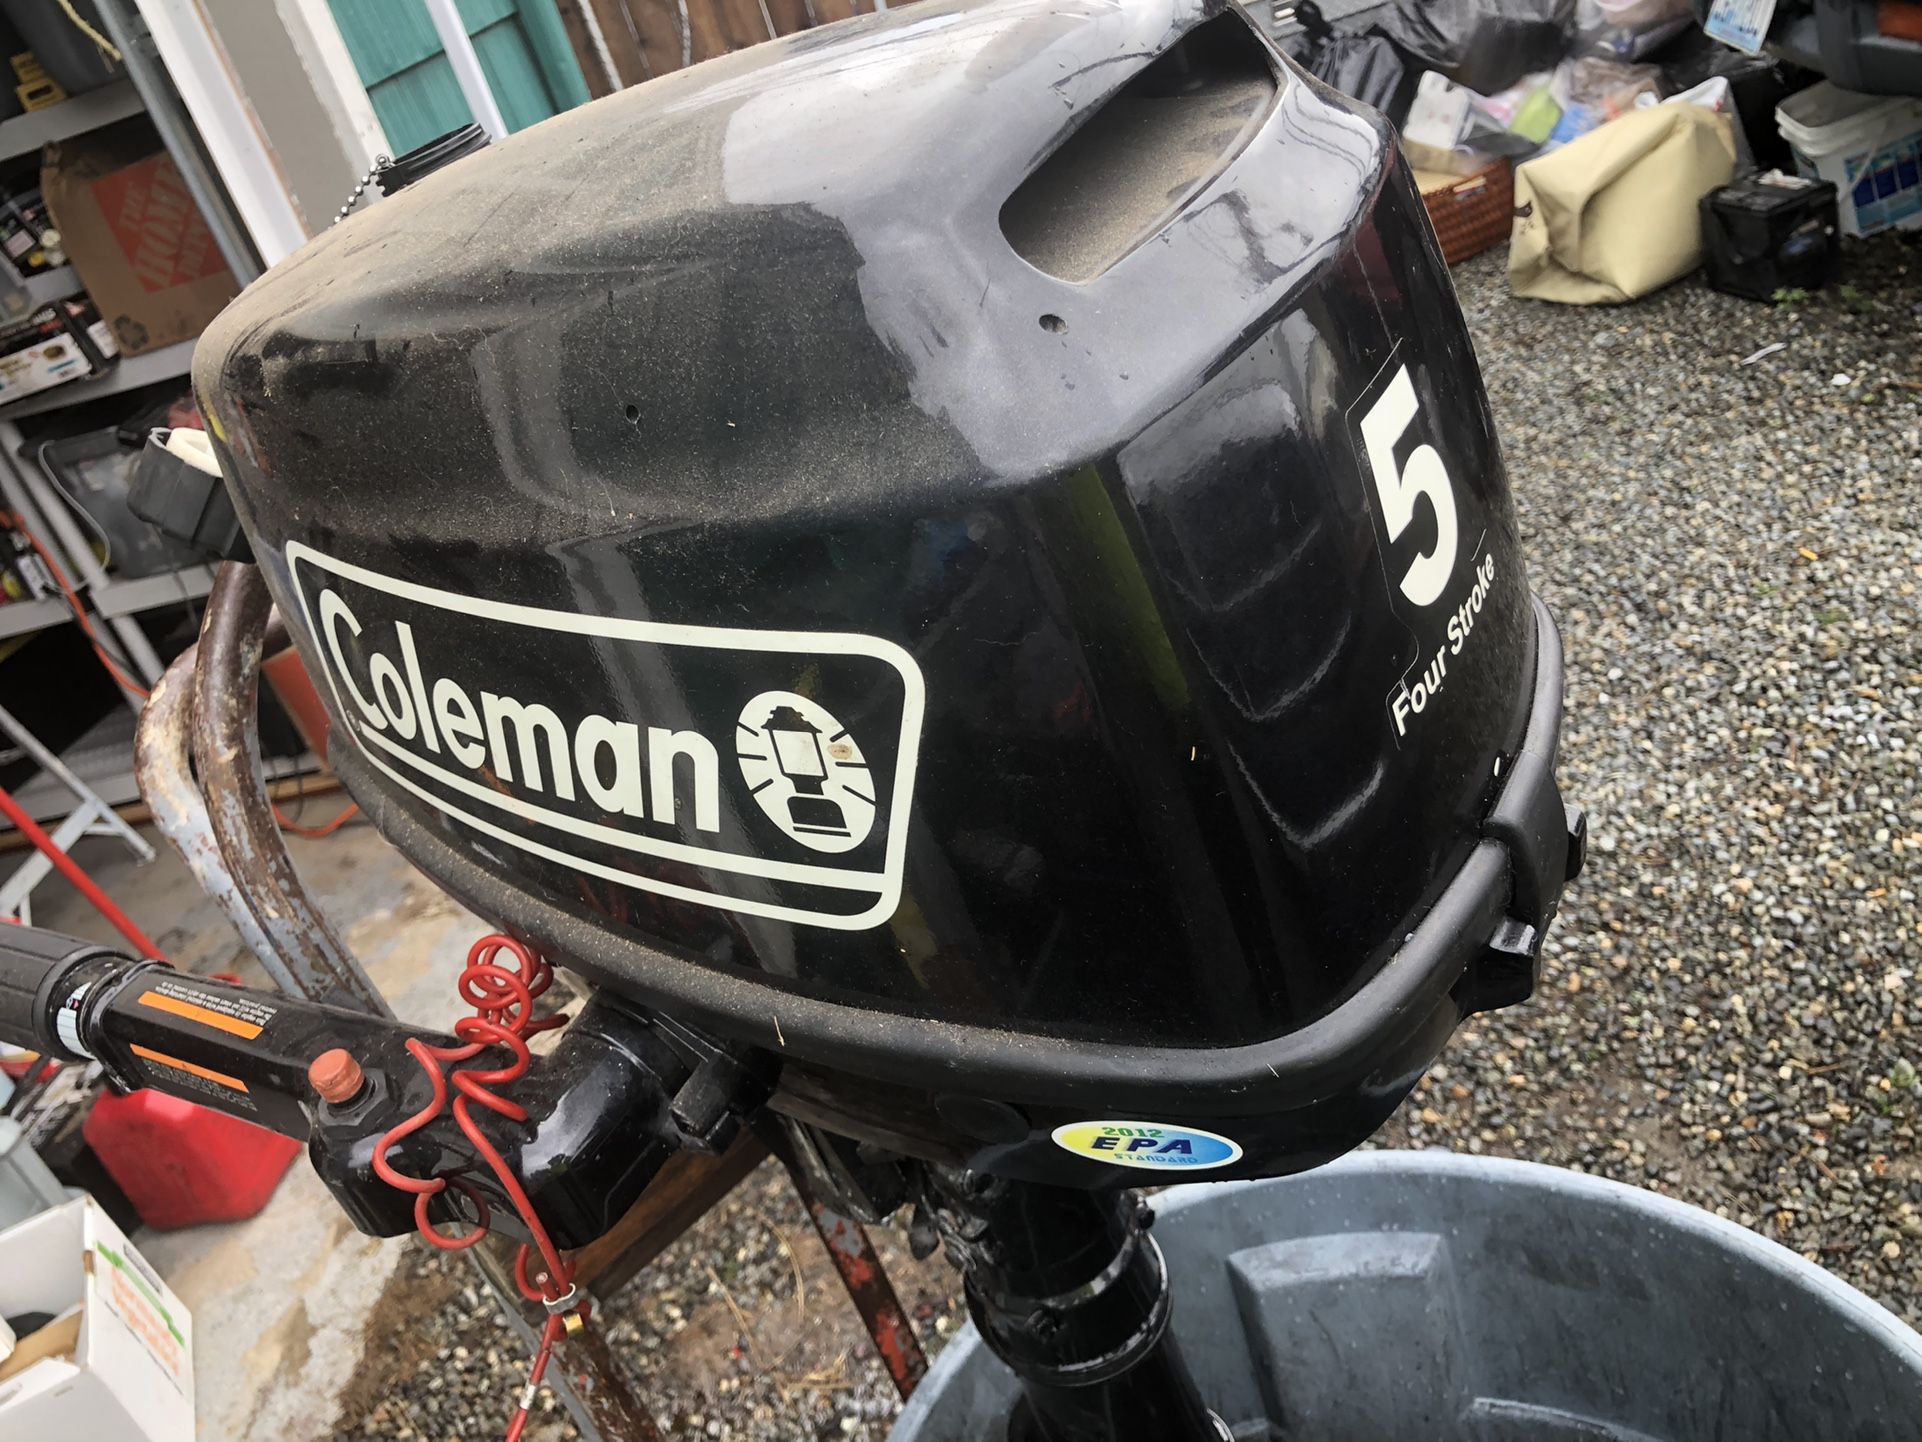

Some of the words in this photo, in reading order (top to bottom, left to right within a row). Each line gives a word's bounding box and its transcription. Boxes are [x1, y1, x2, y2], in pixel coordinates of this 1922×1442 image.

[1360, 363, 1458, 606] 5
[1391, 646, 1447, 736] Four
[1447, 554, 1494, 656] Stroke
[320, 589, 719, 833] Coleman
[1091, 1136, 1193, 1154] EPA
[1102, 1127, 1165, 1137] 2012
[1115, 1153, 1198, 1164] STANDARD
